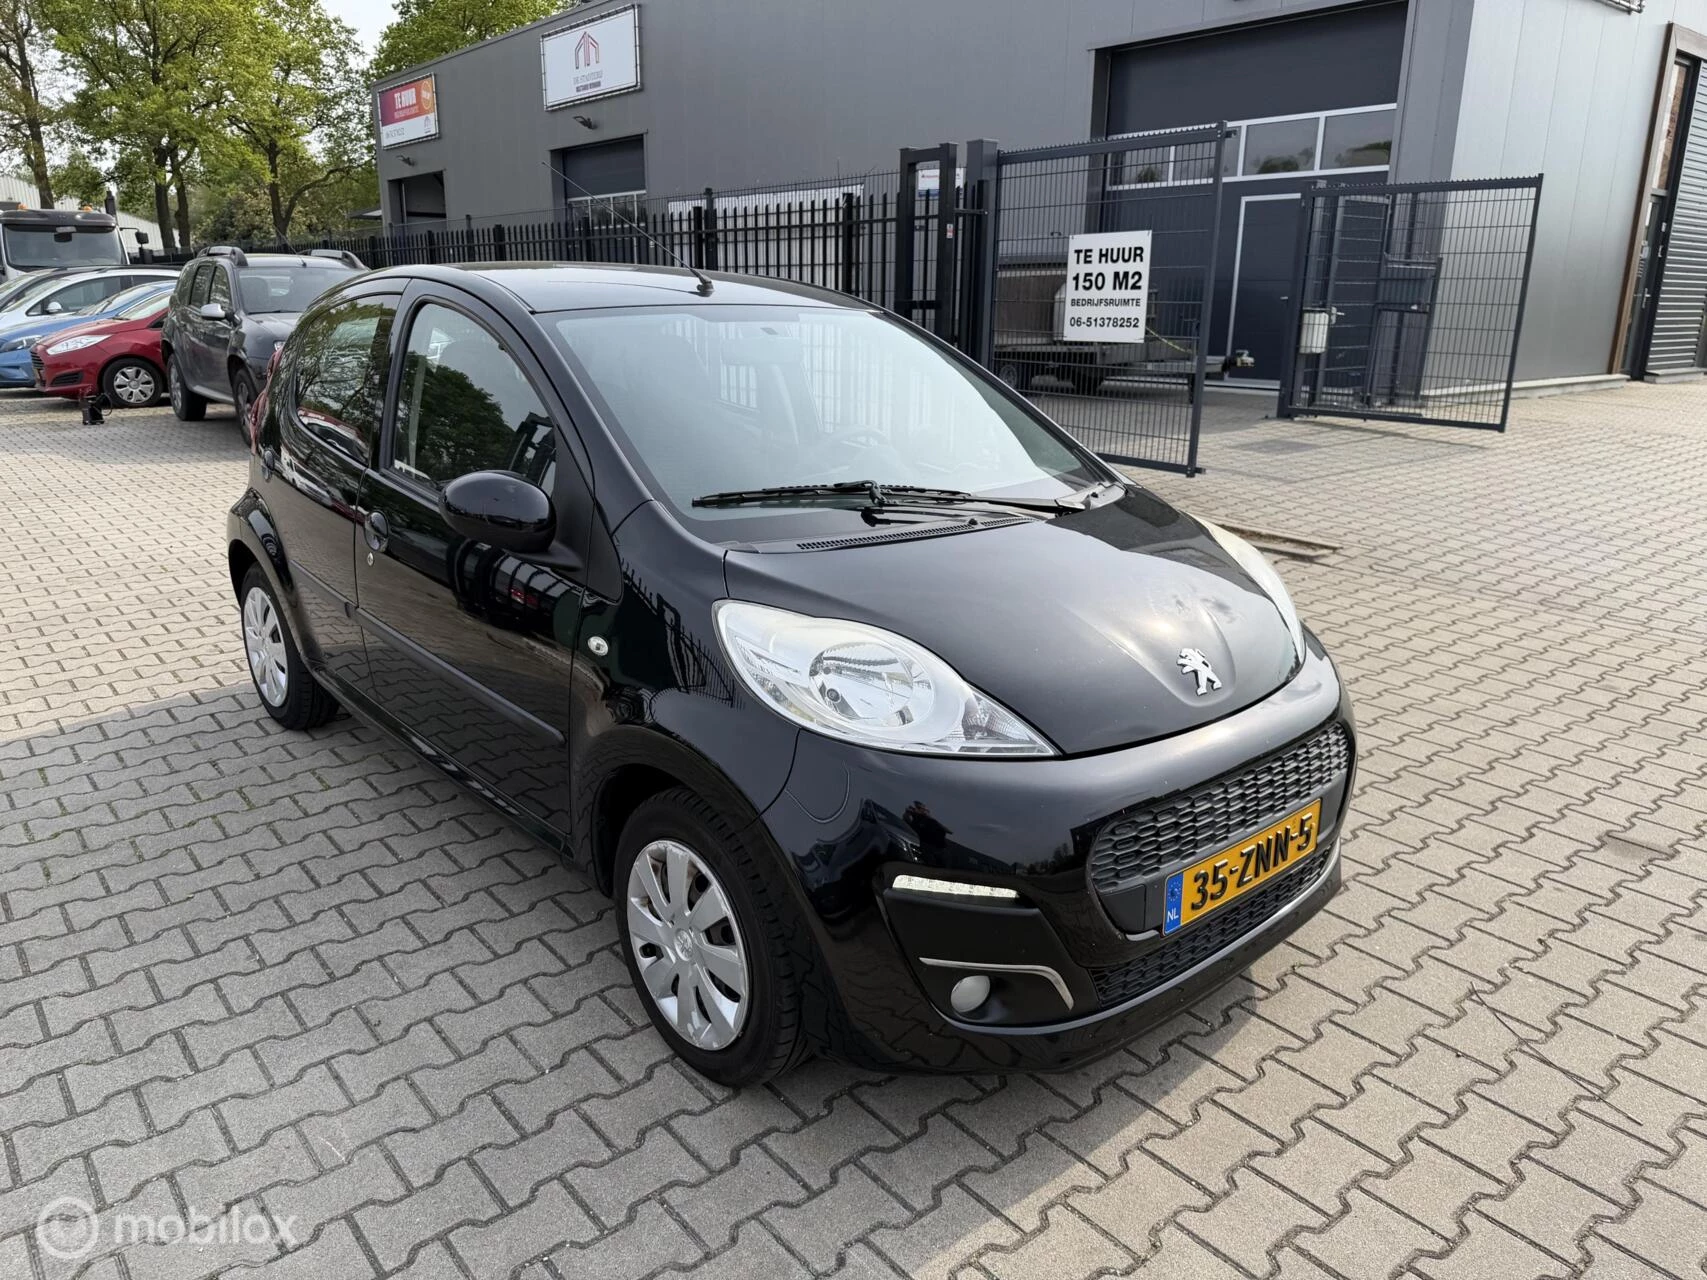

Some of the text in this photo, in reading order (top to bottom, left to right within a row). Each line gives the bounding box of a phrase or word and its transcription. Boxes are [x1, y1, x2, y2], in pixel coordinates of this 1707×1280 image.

[394, 92, 401, 109] TE
[401, 88, 416, 107] HUUR
[1074, 246, 1144, 265] TE HUUR
[1072, 271, 1143, 291] 150 M2
[1070, 298, 1141, 307] BEDRIJFSRUIMTE
[1069, 316, 1140, 328] 06-51378252
[1191, 812, 1316, 911] 35-ZNN-5
[1166, 910, 1179, 923] NL
